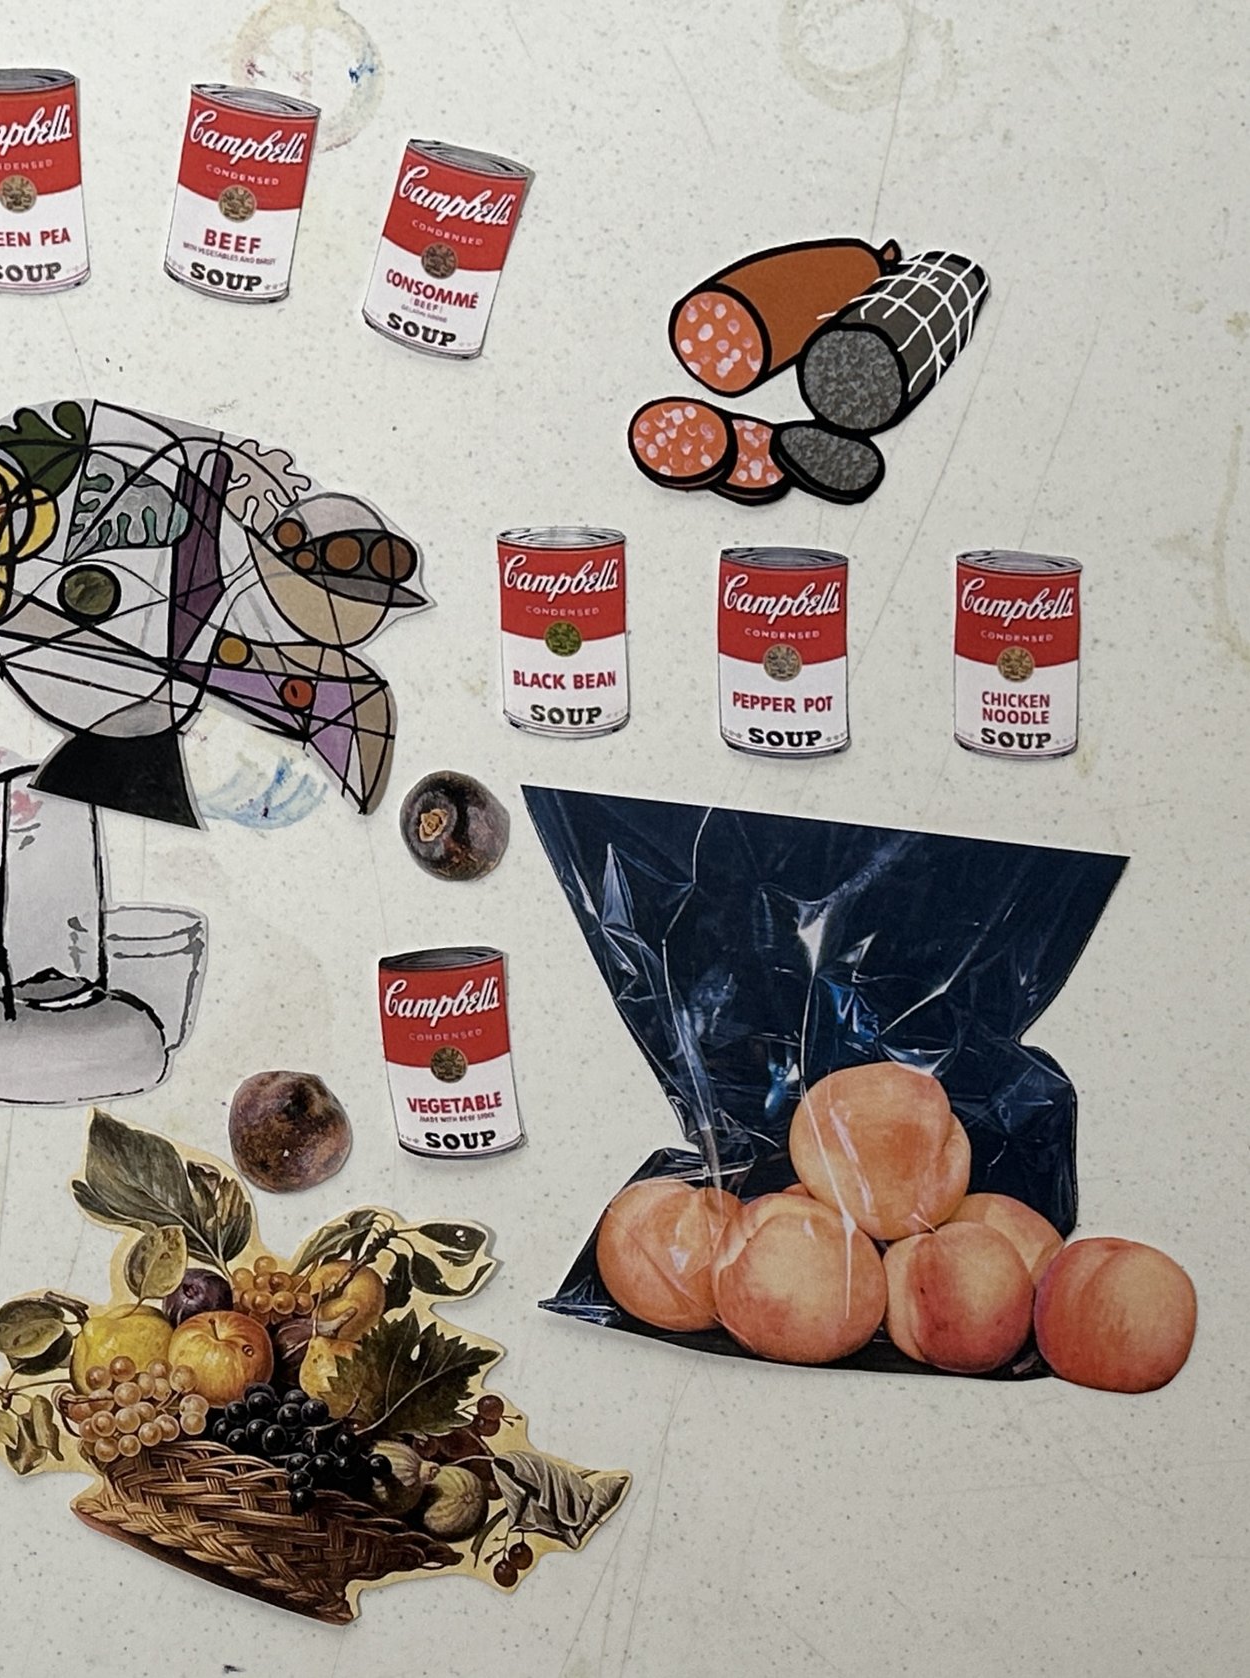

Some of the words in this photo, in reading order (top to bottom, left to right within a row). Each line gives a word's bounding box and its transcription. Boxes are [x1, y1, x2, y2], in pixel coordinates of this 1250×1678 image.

[206, 164, 279, 186] CONDENSED
[40, 228, 71, 246] PEA
[204, 228, 261, 254] BEEF
[411, 219, 484, 246] CONDENSED
[190, 262, 262, 292] SOUP
[386, 268, 479, 309] CONSOMMÉ
[387, 312, 456, 347] SOUP
[525, 605, 600, 617] CONDENSED
[744, 628, 820, 639] CONDENSED
[980, 630, 1053, 642] CONDENSED
[513, 670, 566, 690] BLACK
[573, 670, 616, 690] BEAN
[733, 691, 796, 713] PEPPER
[804, 695, 833, 713] POT
[982, 691, 1050, 709] CHICKEN
[530, 704, 602, 726] SOUP
[982, 707, 1050, 725] NOODLE
[748, 727, 822, 747] SOUP
[981, 727, 1052, 749] SOUP
[408, 1028, 483, 1041] CONDENSED
[407, 1091, 502, 1113] VEGETABLE
[425, 1130, 496, 1149] SOUP
